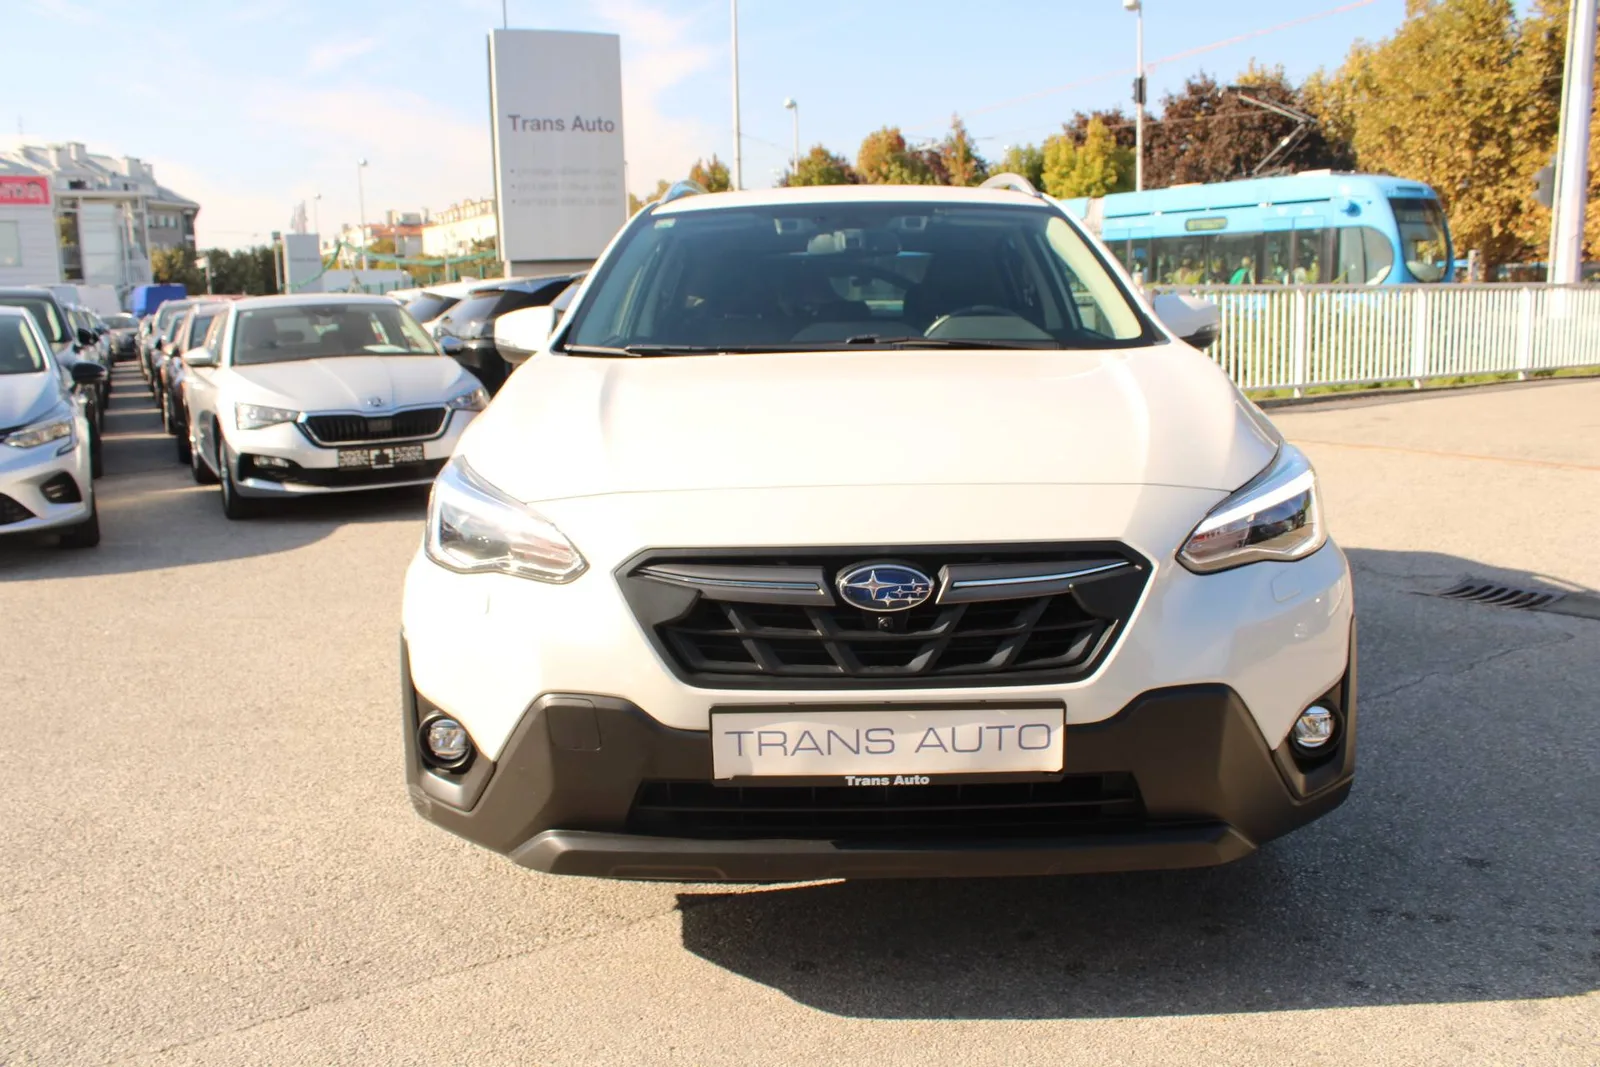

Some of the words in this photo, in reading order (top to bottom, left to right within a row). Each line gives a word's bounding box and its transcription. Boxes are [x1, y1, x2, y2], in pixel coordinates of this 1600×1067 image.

[507, 114, 565, 132] Trans
[571, 115, 616, 132] Auto
[724, 727, 895, 757] TRANS
[914, 723, 1052, 753] AUTO
[845, 775, 890, 786] Trans
[893, 774, 931, 785] Auto
